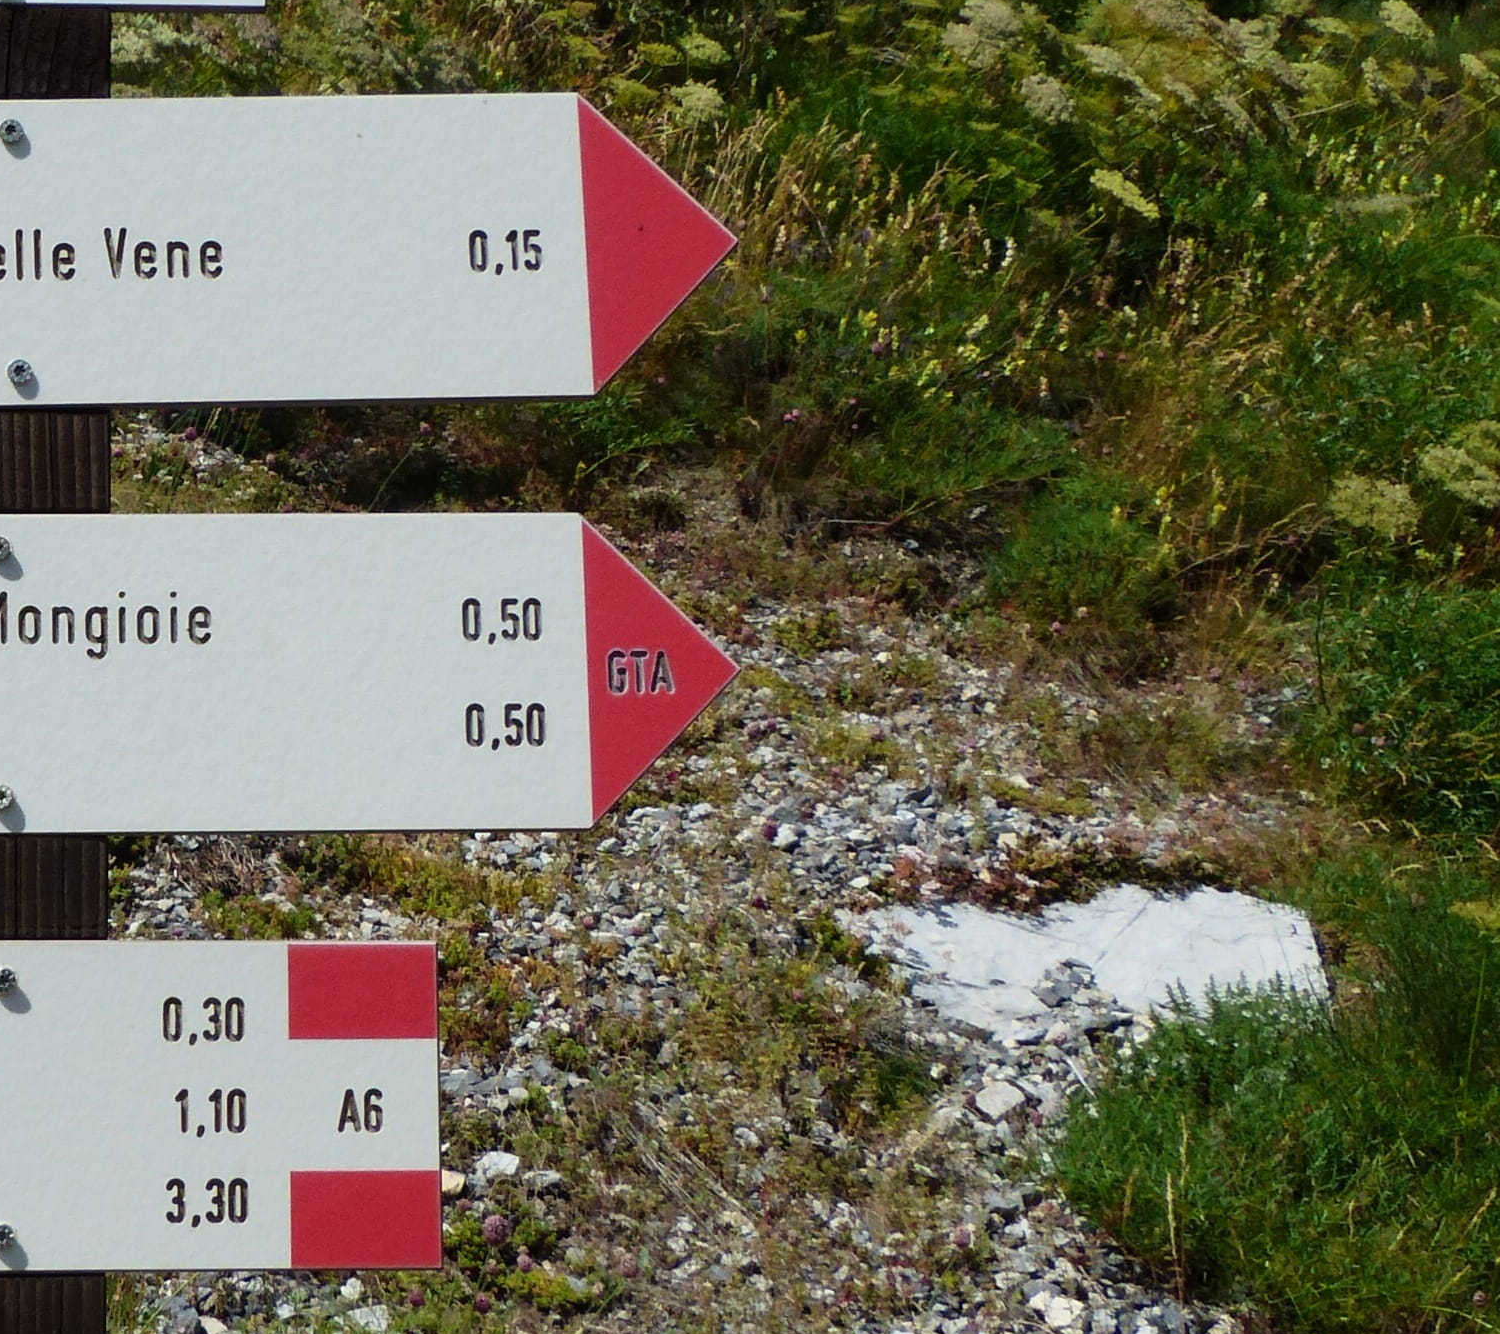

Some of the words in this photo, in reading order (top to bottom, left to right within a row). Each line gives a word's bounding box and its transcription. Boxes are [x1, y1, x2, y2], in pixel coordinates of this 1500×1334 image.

[103, 227, 223, 280] Vene
[468, 229, 543, 276] 0,15
[461, 597, 542, 645] 0,50
[607, 649, 677, 696] GTA
[465, 702, 546, 751] 0,50
[162, 996, 245, 1046] 0,30
[174, 1088, 247, 1138] 1,10
[337, 1087, 383, 1133] A6
[165, 1177, 249, 1228] 3,30
